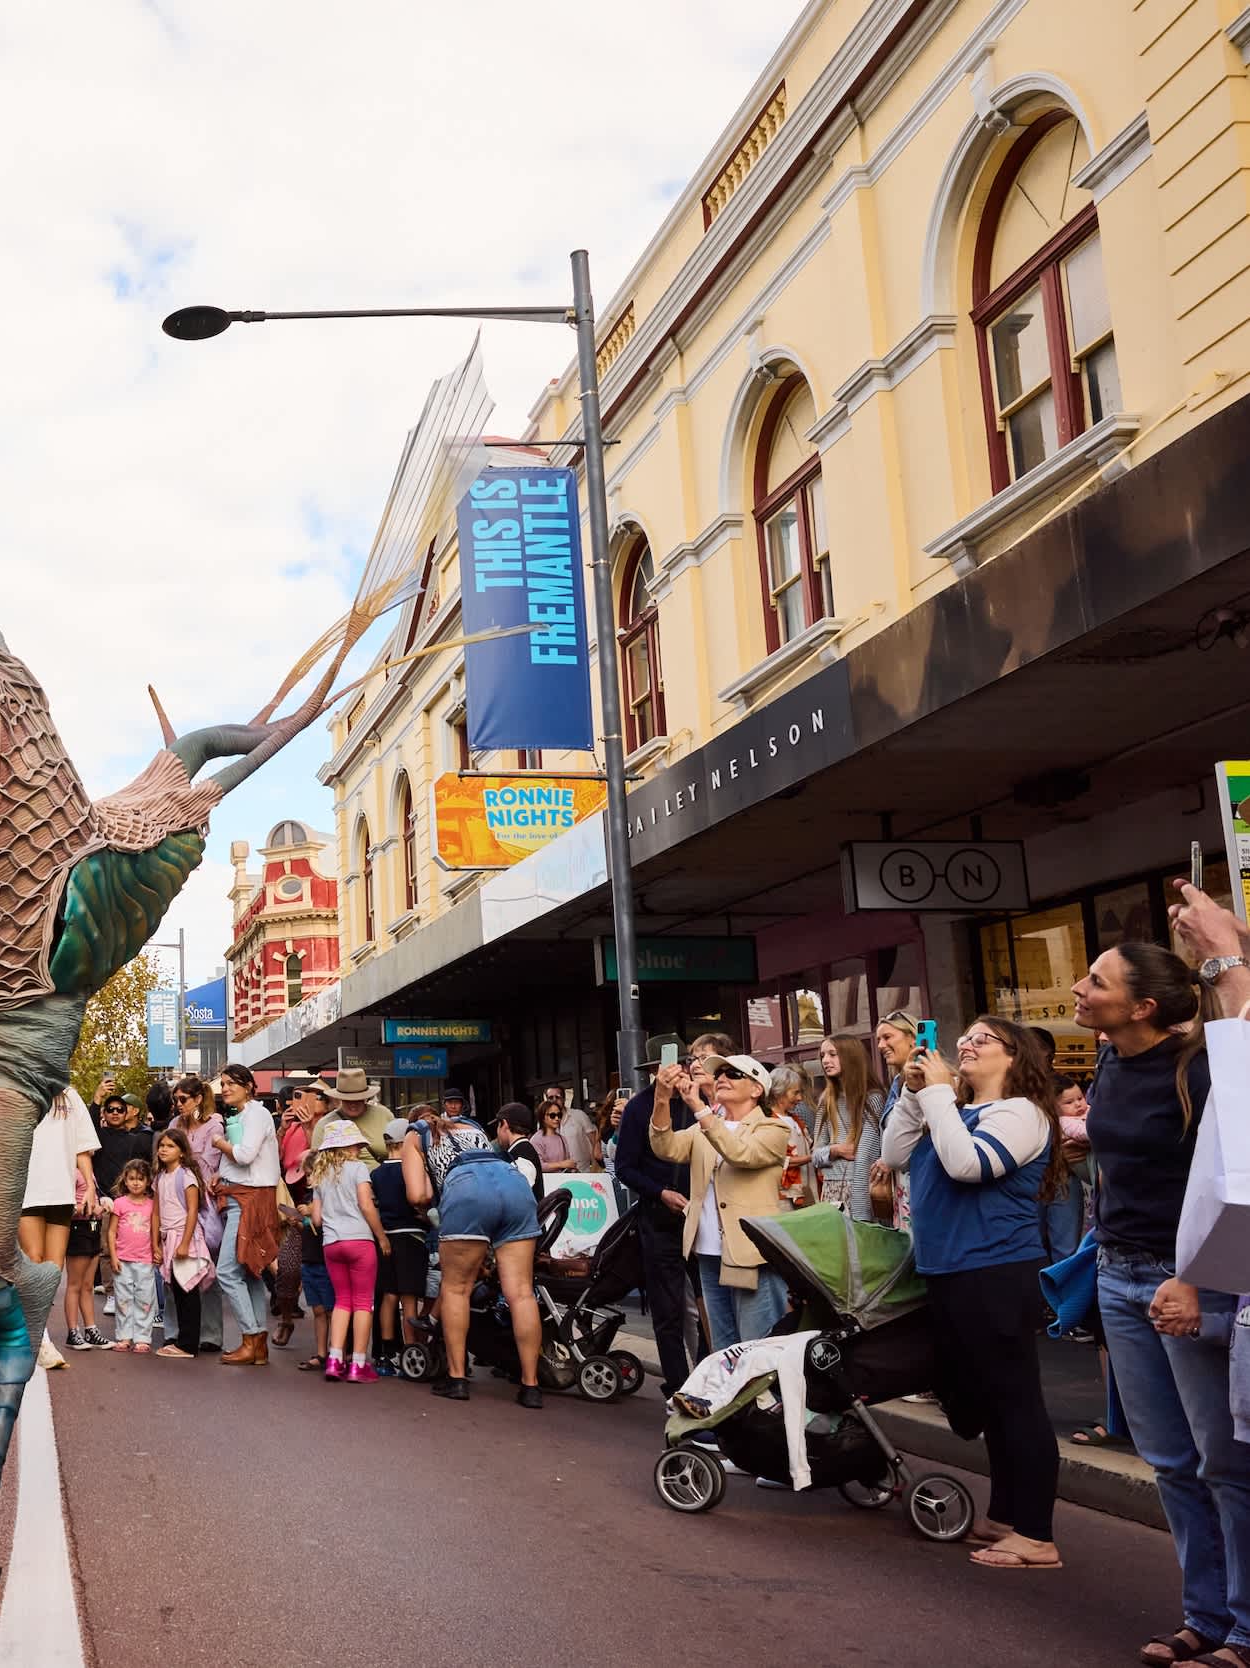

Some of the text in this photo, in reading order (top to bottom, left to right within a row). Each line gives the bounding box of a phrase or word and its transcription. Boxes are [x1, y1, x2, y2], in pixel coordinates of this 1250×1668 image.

[469, 478, 524, 593] THIS IS
[520, 478, 578, 665] FREMANTLE
[711, 708, 824, 790] NELSON
[484, 788, 574, 808] RONNIE
[486, 808, 576, 828] NIGHTS
[163, 993, 177, 1045] FREMANTLE
[187, 1005, 213, 1020] Sosta
[397, 1026, 479, 1036] RONNIE NIGHTS
